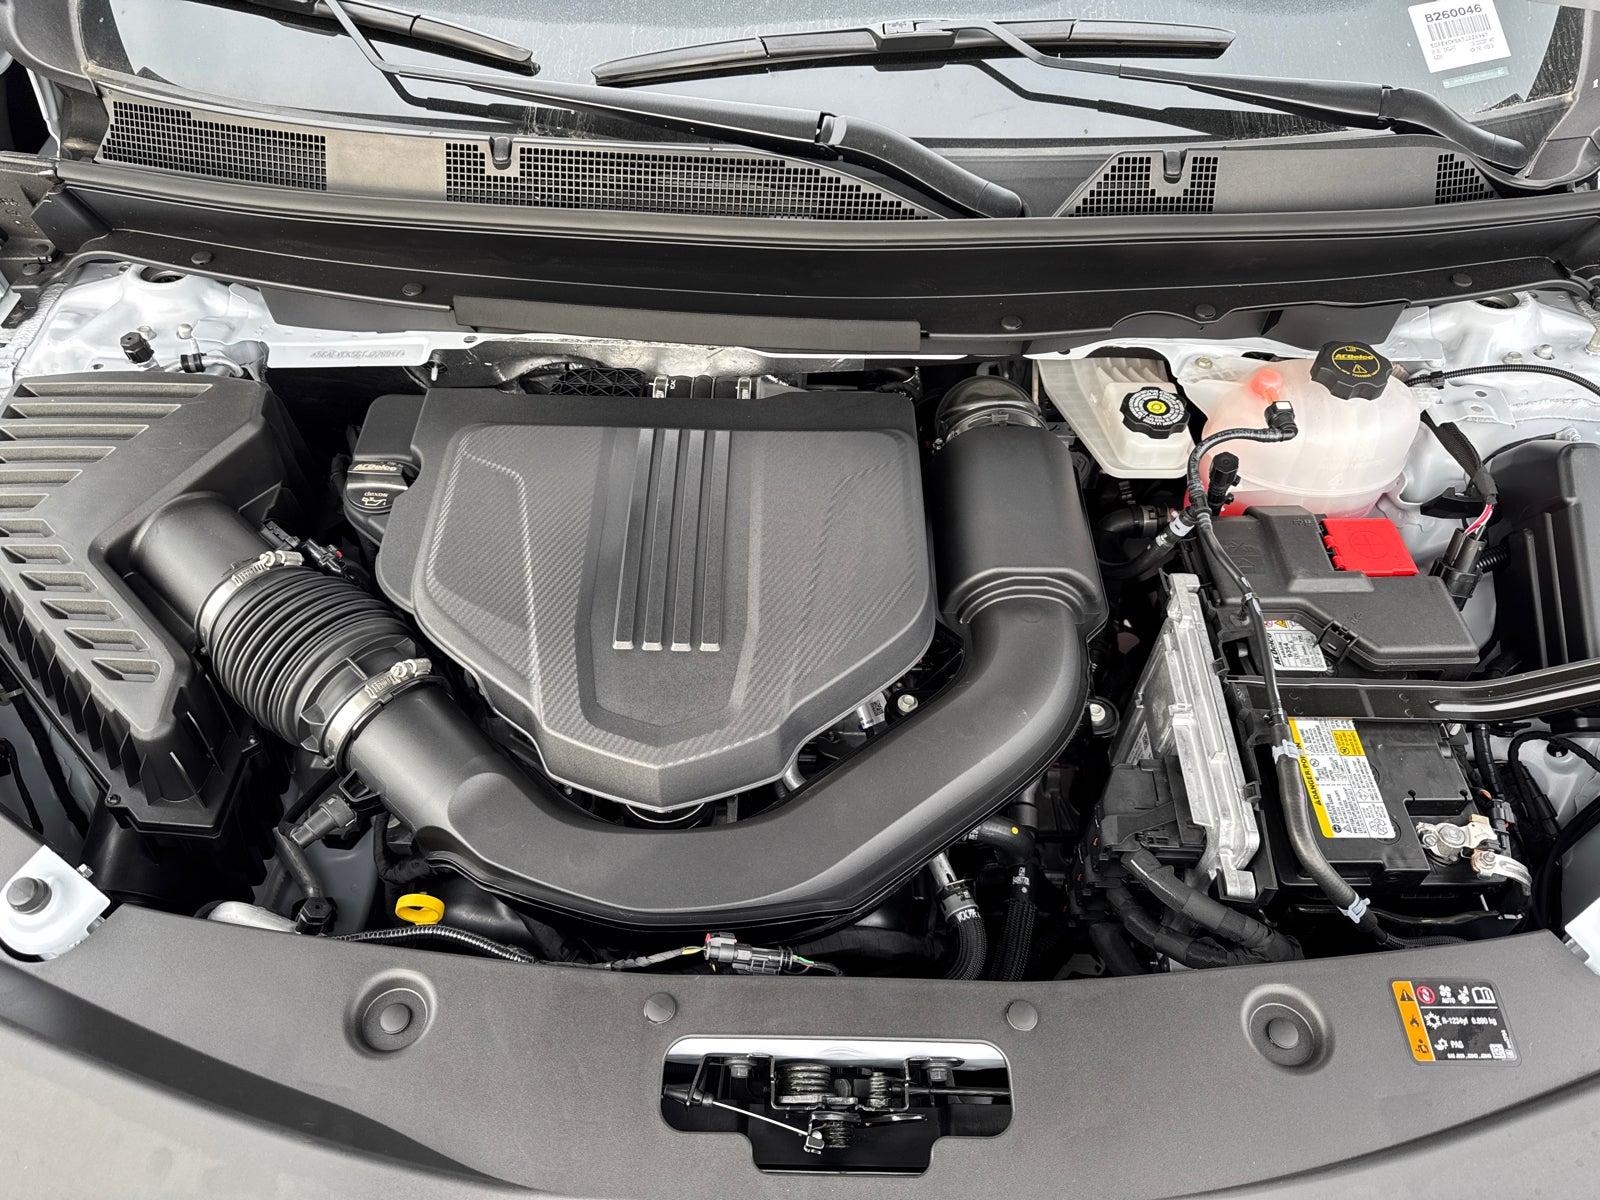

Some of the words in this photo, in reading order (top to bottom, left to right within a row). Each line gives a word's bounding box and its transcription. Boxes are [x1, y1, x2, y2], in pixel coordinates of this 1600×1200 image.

[1424, 4, 1482, 22] B260046
[1267, 632, 1282, 666] ACDelco
[1489, 1017, 1497, 1026] kg
[1450, 1040, 1464, 1049] PAG
